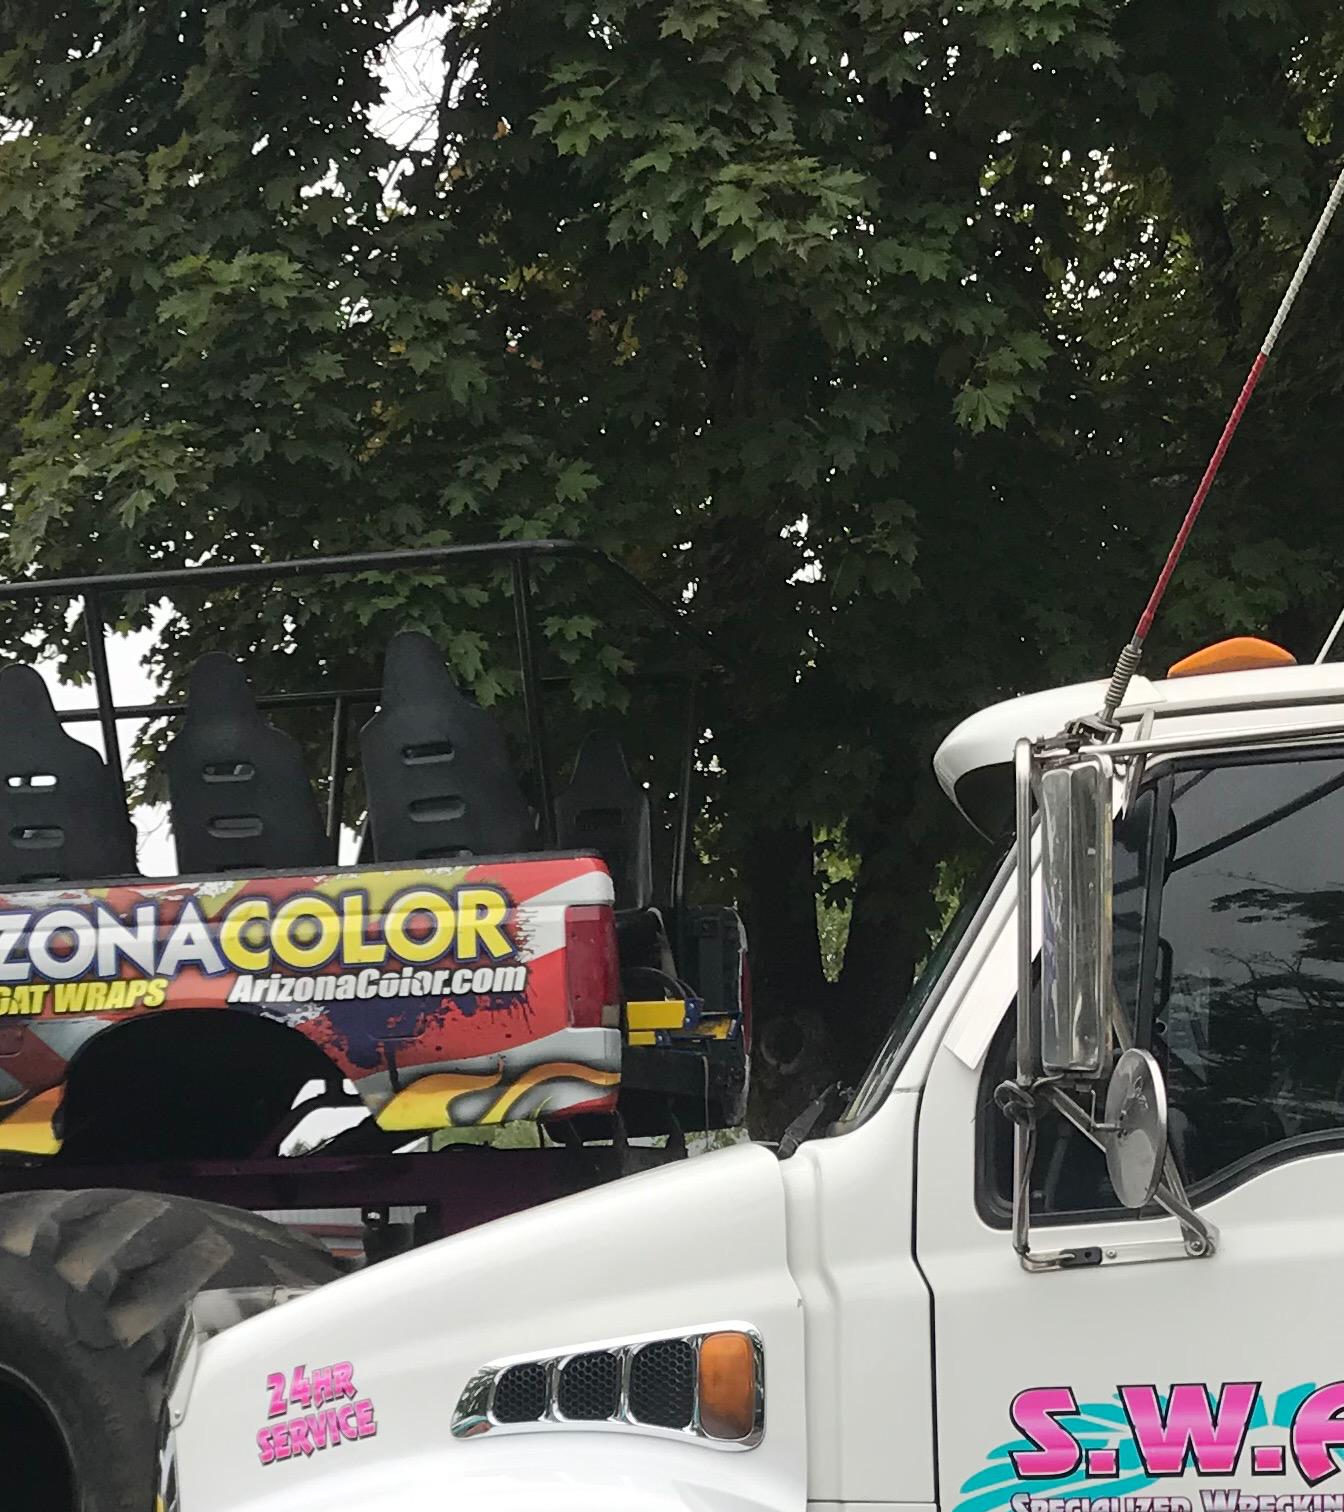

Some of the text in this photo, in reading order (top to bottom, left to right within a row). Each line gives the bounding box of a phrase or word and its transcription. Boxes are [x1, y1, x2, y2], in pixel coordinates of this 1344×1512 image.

[54, 979, 169, 1013] WRAPS
[227, 966, 527, 1003] ArizonaColor.com
[256, 1398, 377, 1466] SERVICE
